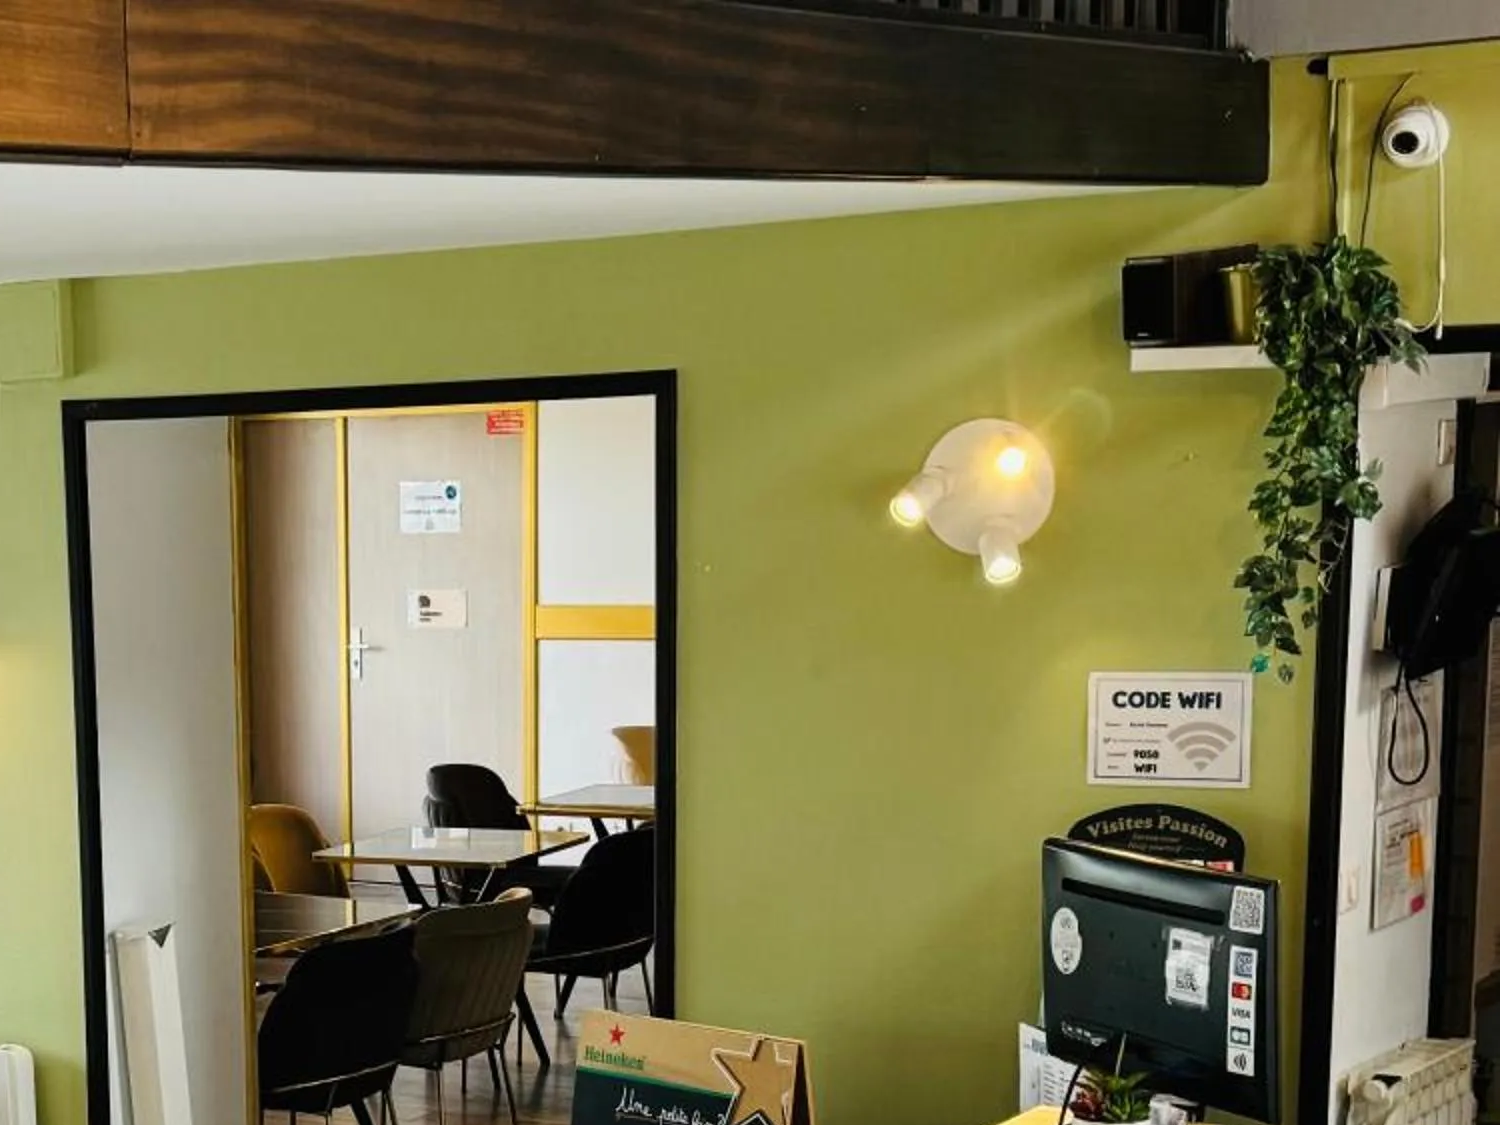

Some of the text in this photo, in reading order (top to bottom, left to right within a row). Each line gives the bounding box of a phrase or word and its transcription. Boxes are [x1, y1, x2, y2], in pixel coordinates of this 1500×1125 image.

[1111, 690, 1222, 710] CODE WIFI
[1087, 814, 1153, 838] Visites
[1158, 814, 1228, 848] Passion
[1231, 1006, 1252, 1020] VISA
[583, 1044, 645, 1071] Heineken
